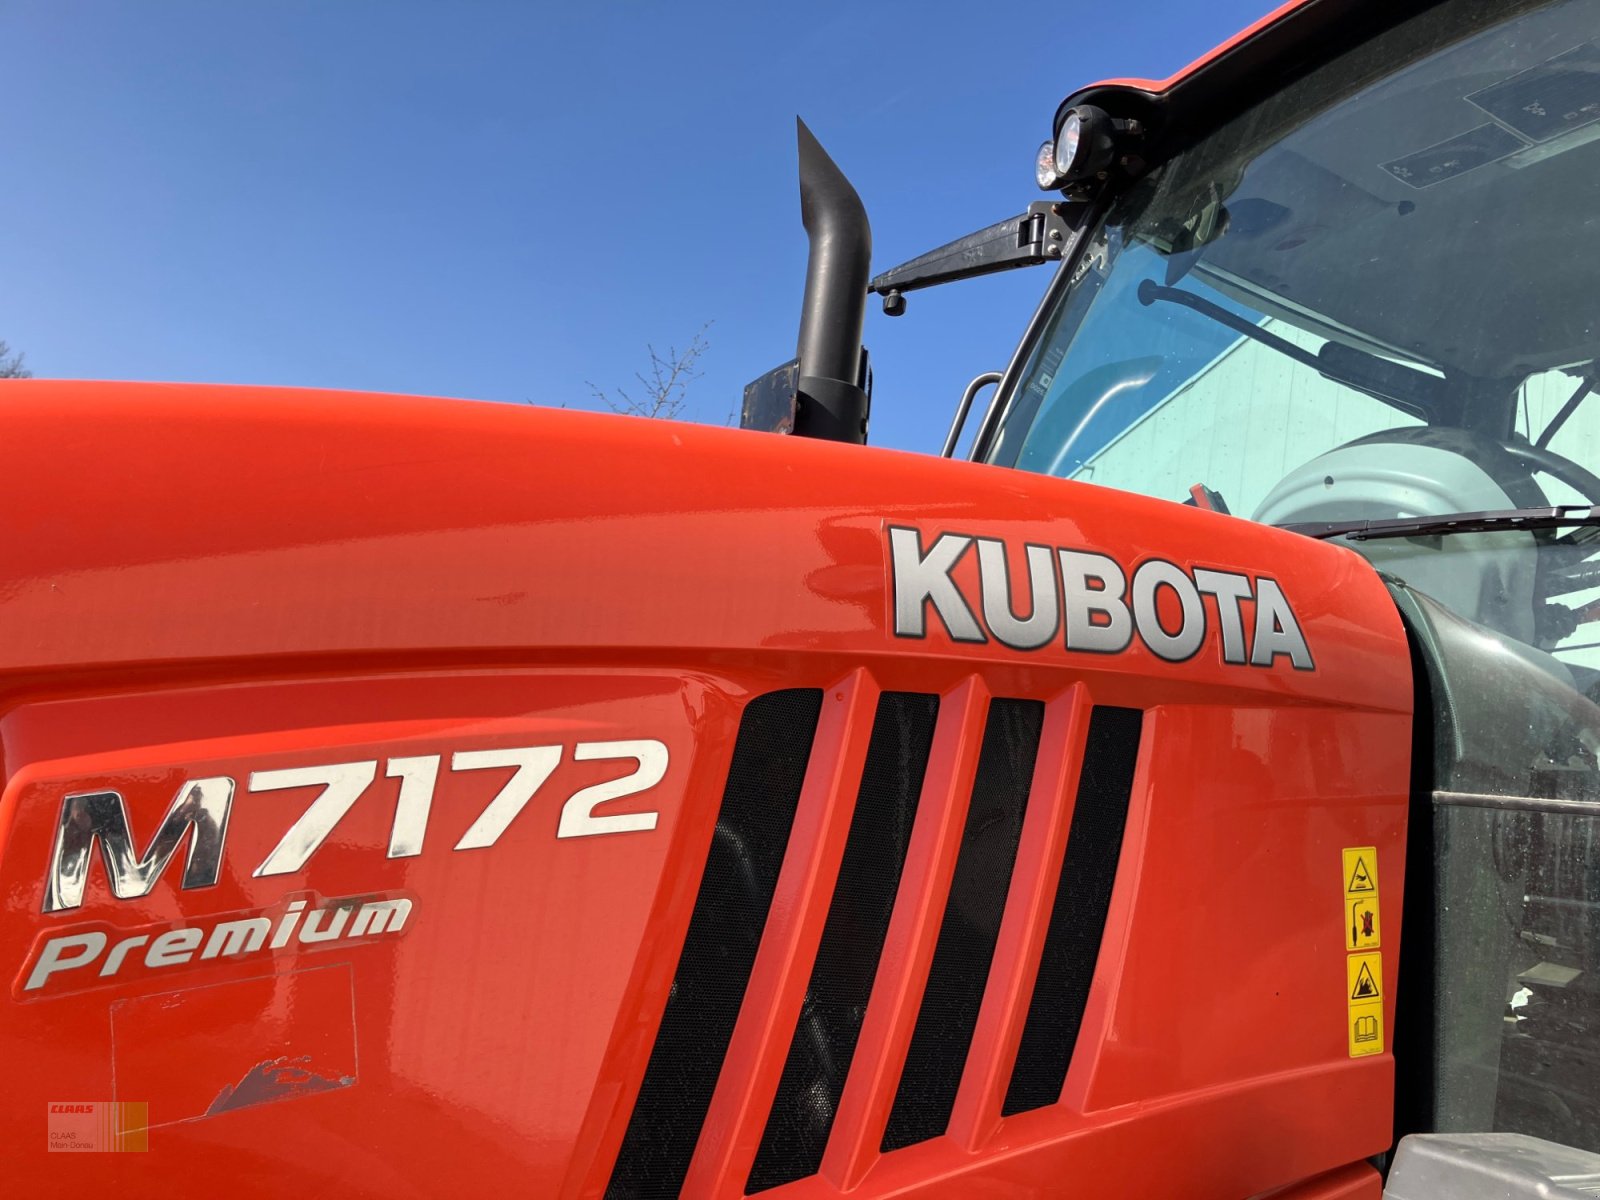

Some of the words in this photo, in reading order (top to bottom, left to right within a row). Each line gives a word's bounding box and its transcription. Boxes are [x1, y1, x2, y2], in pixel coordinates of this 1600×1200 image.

[888, 526, 1315, 671] KUBOTA
[42, 739, 670, 913] M7172
[24, 899, 413, 991] Premium
